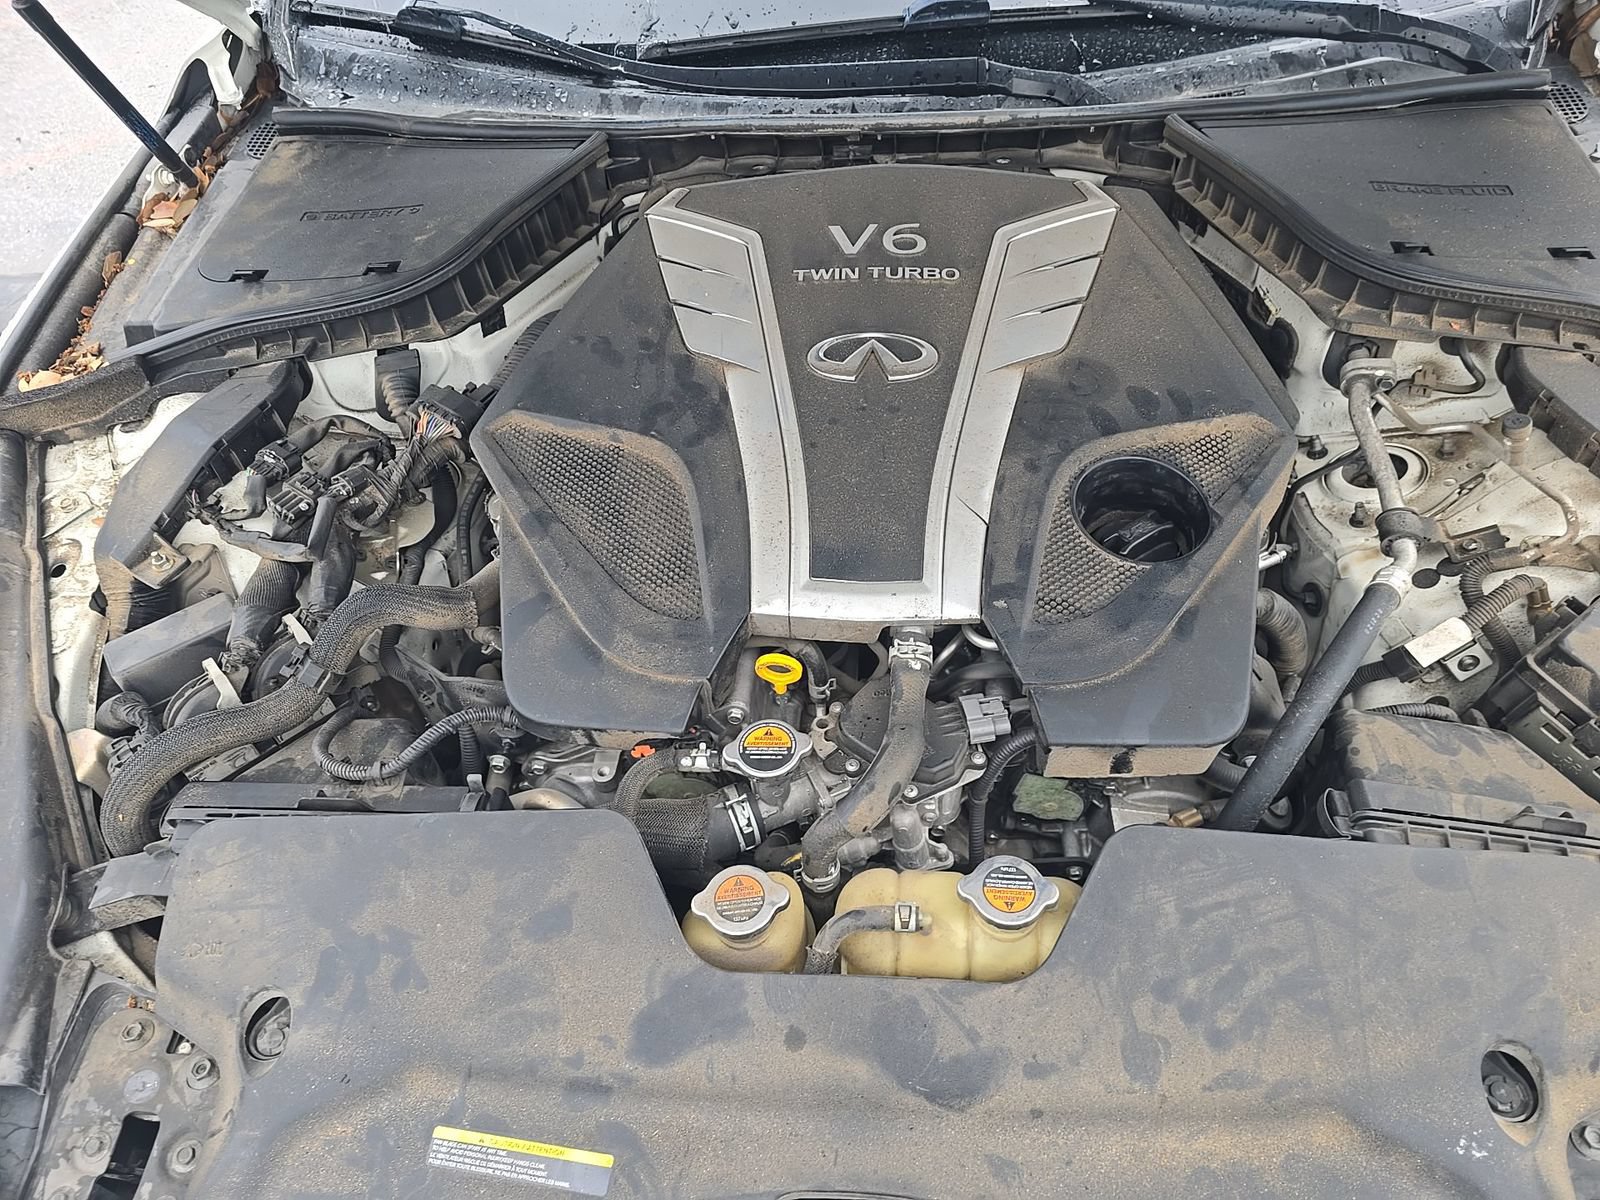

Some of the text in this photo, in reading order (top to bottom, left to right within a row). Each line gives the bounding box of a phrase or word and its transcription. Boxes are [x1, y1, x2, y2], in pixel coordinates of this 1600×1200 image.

[1372, 183, 1509, 197] BRAKE FLUID
[323, 207, 405, 221] BATTERY
[827, 223, 927, 256] V6
[793, 266, 961, 282] TWIN TURBO
[993, 895, 1025, 903] WARNING
